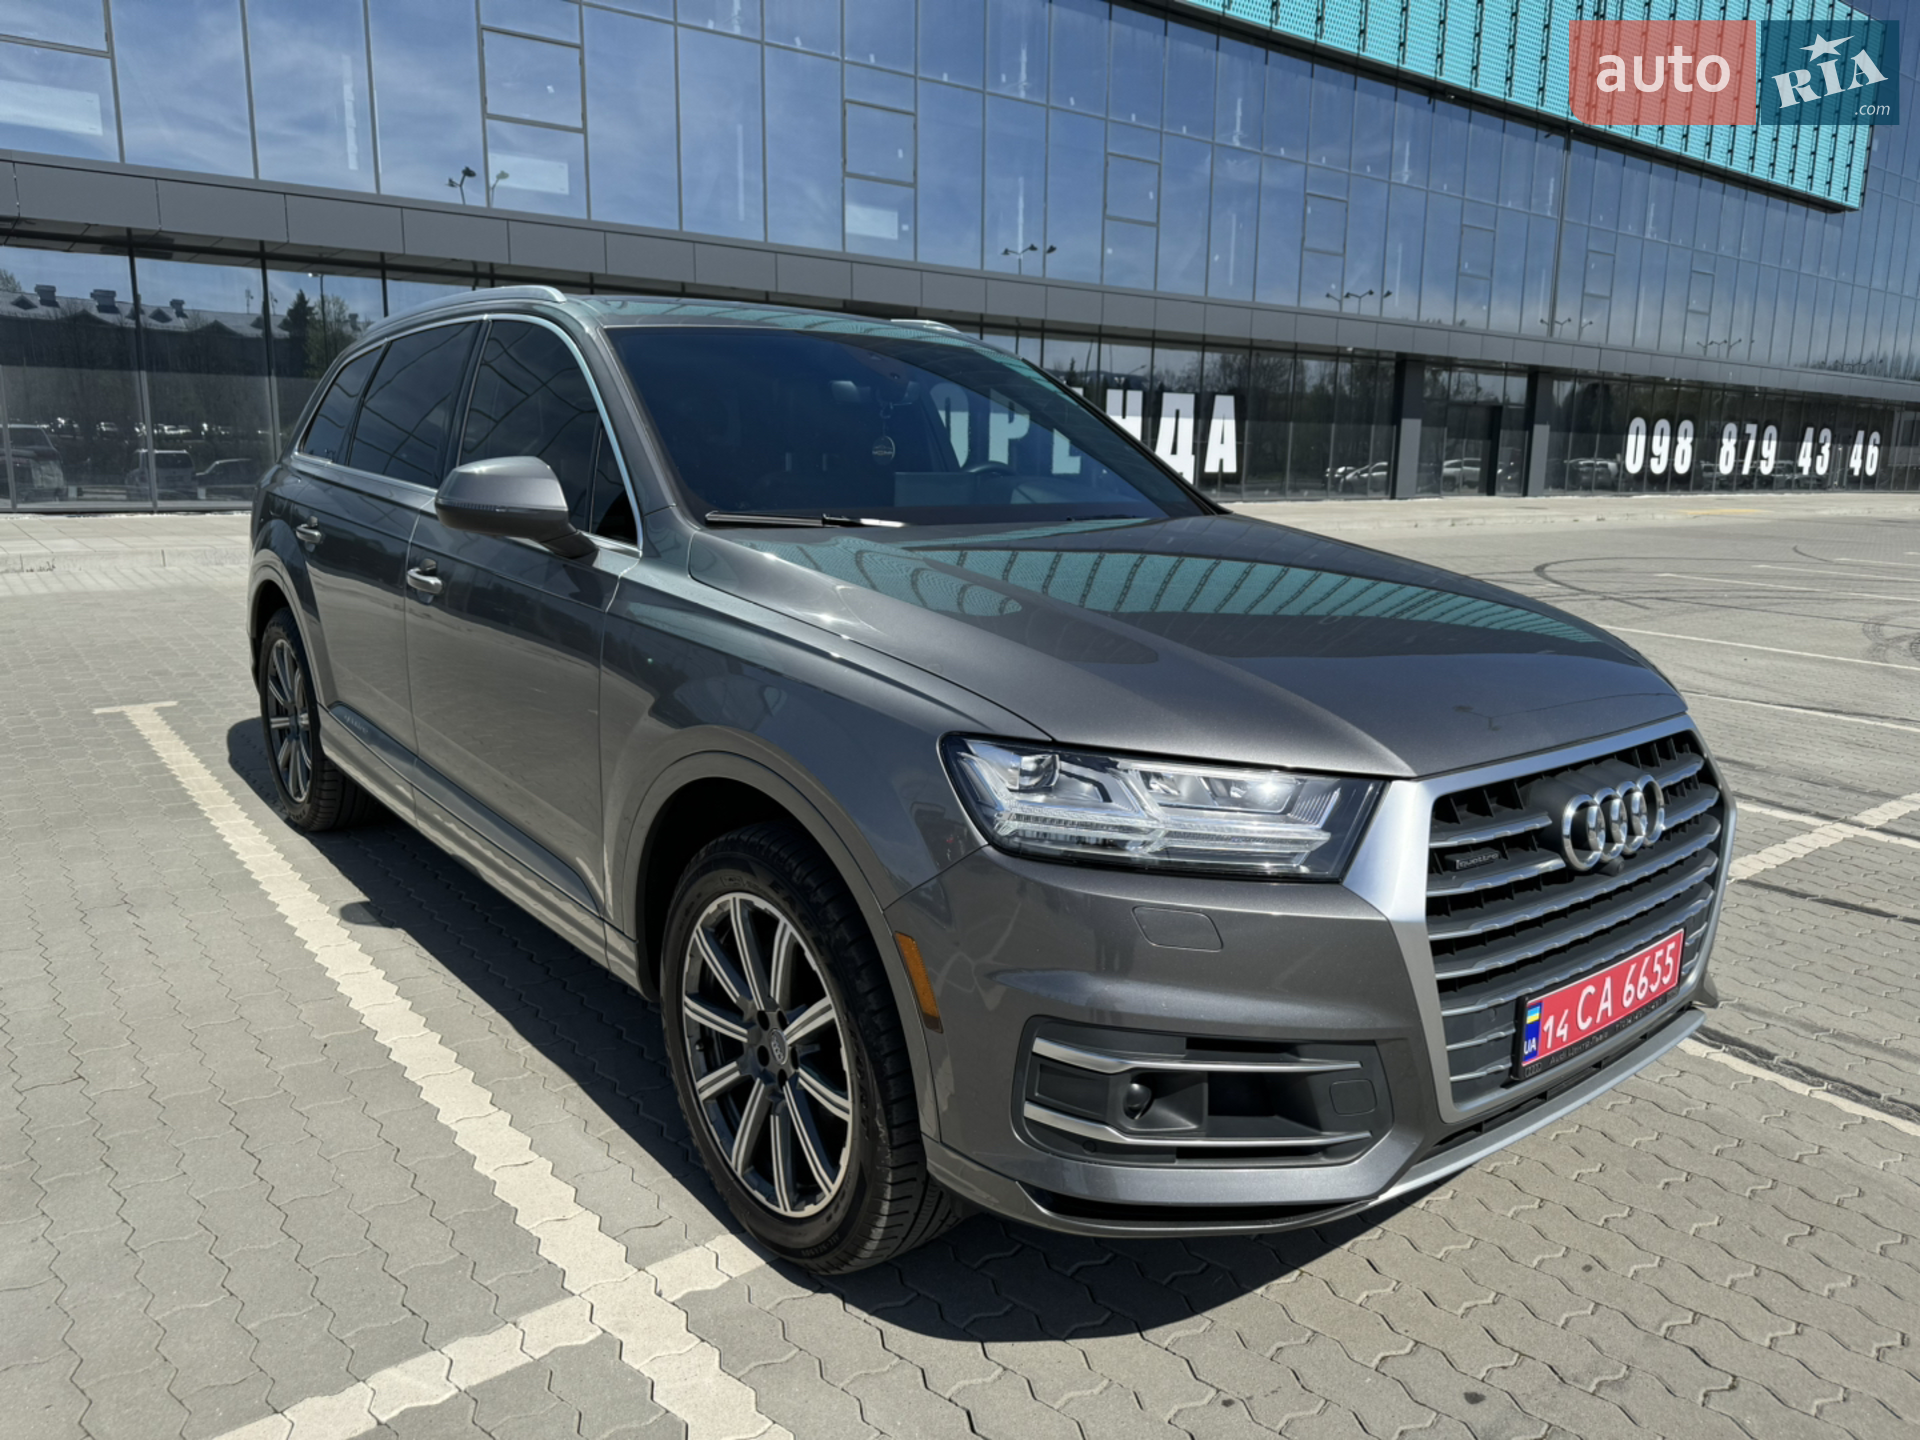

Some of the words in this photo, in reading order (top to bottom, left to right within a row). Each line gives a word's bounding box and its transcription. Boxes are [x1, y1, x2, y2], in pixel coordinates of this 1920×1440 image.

[1625, 417, 1694, 475] 098
[1719, 423, 1777, 476] 879
[1798, 427, 1831, 476] 43
[1850, 430, 1880, 476] 46
[1543, 1009, 1569, 1049] 14
[1576, 976, 1613, 1031] CA
[1622, 941, 1676, 1009] 6655
[1524, 1037, 1536, 1055] UA
